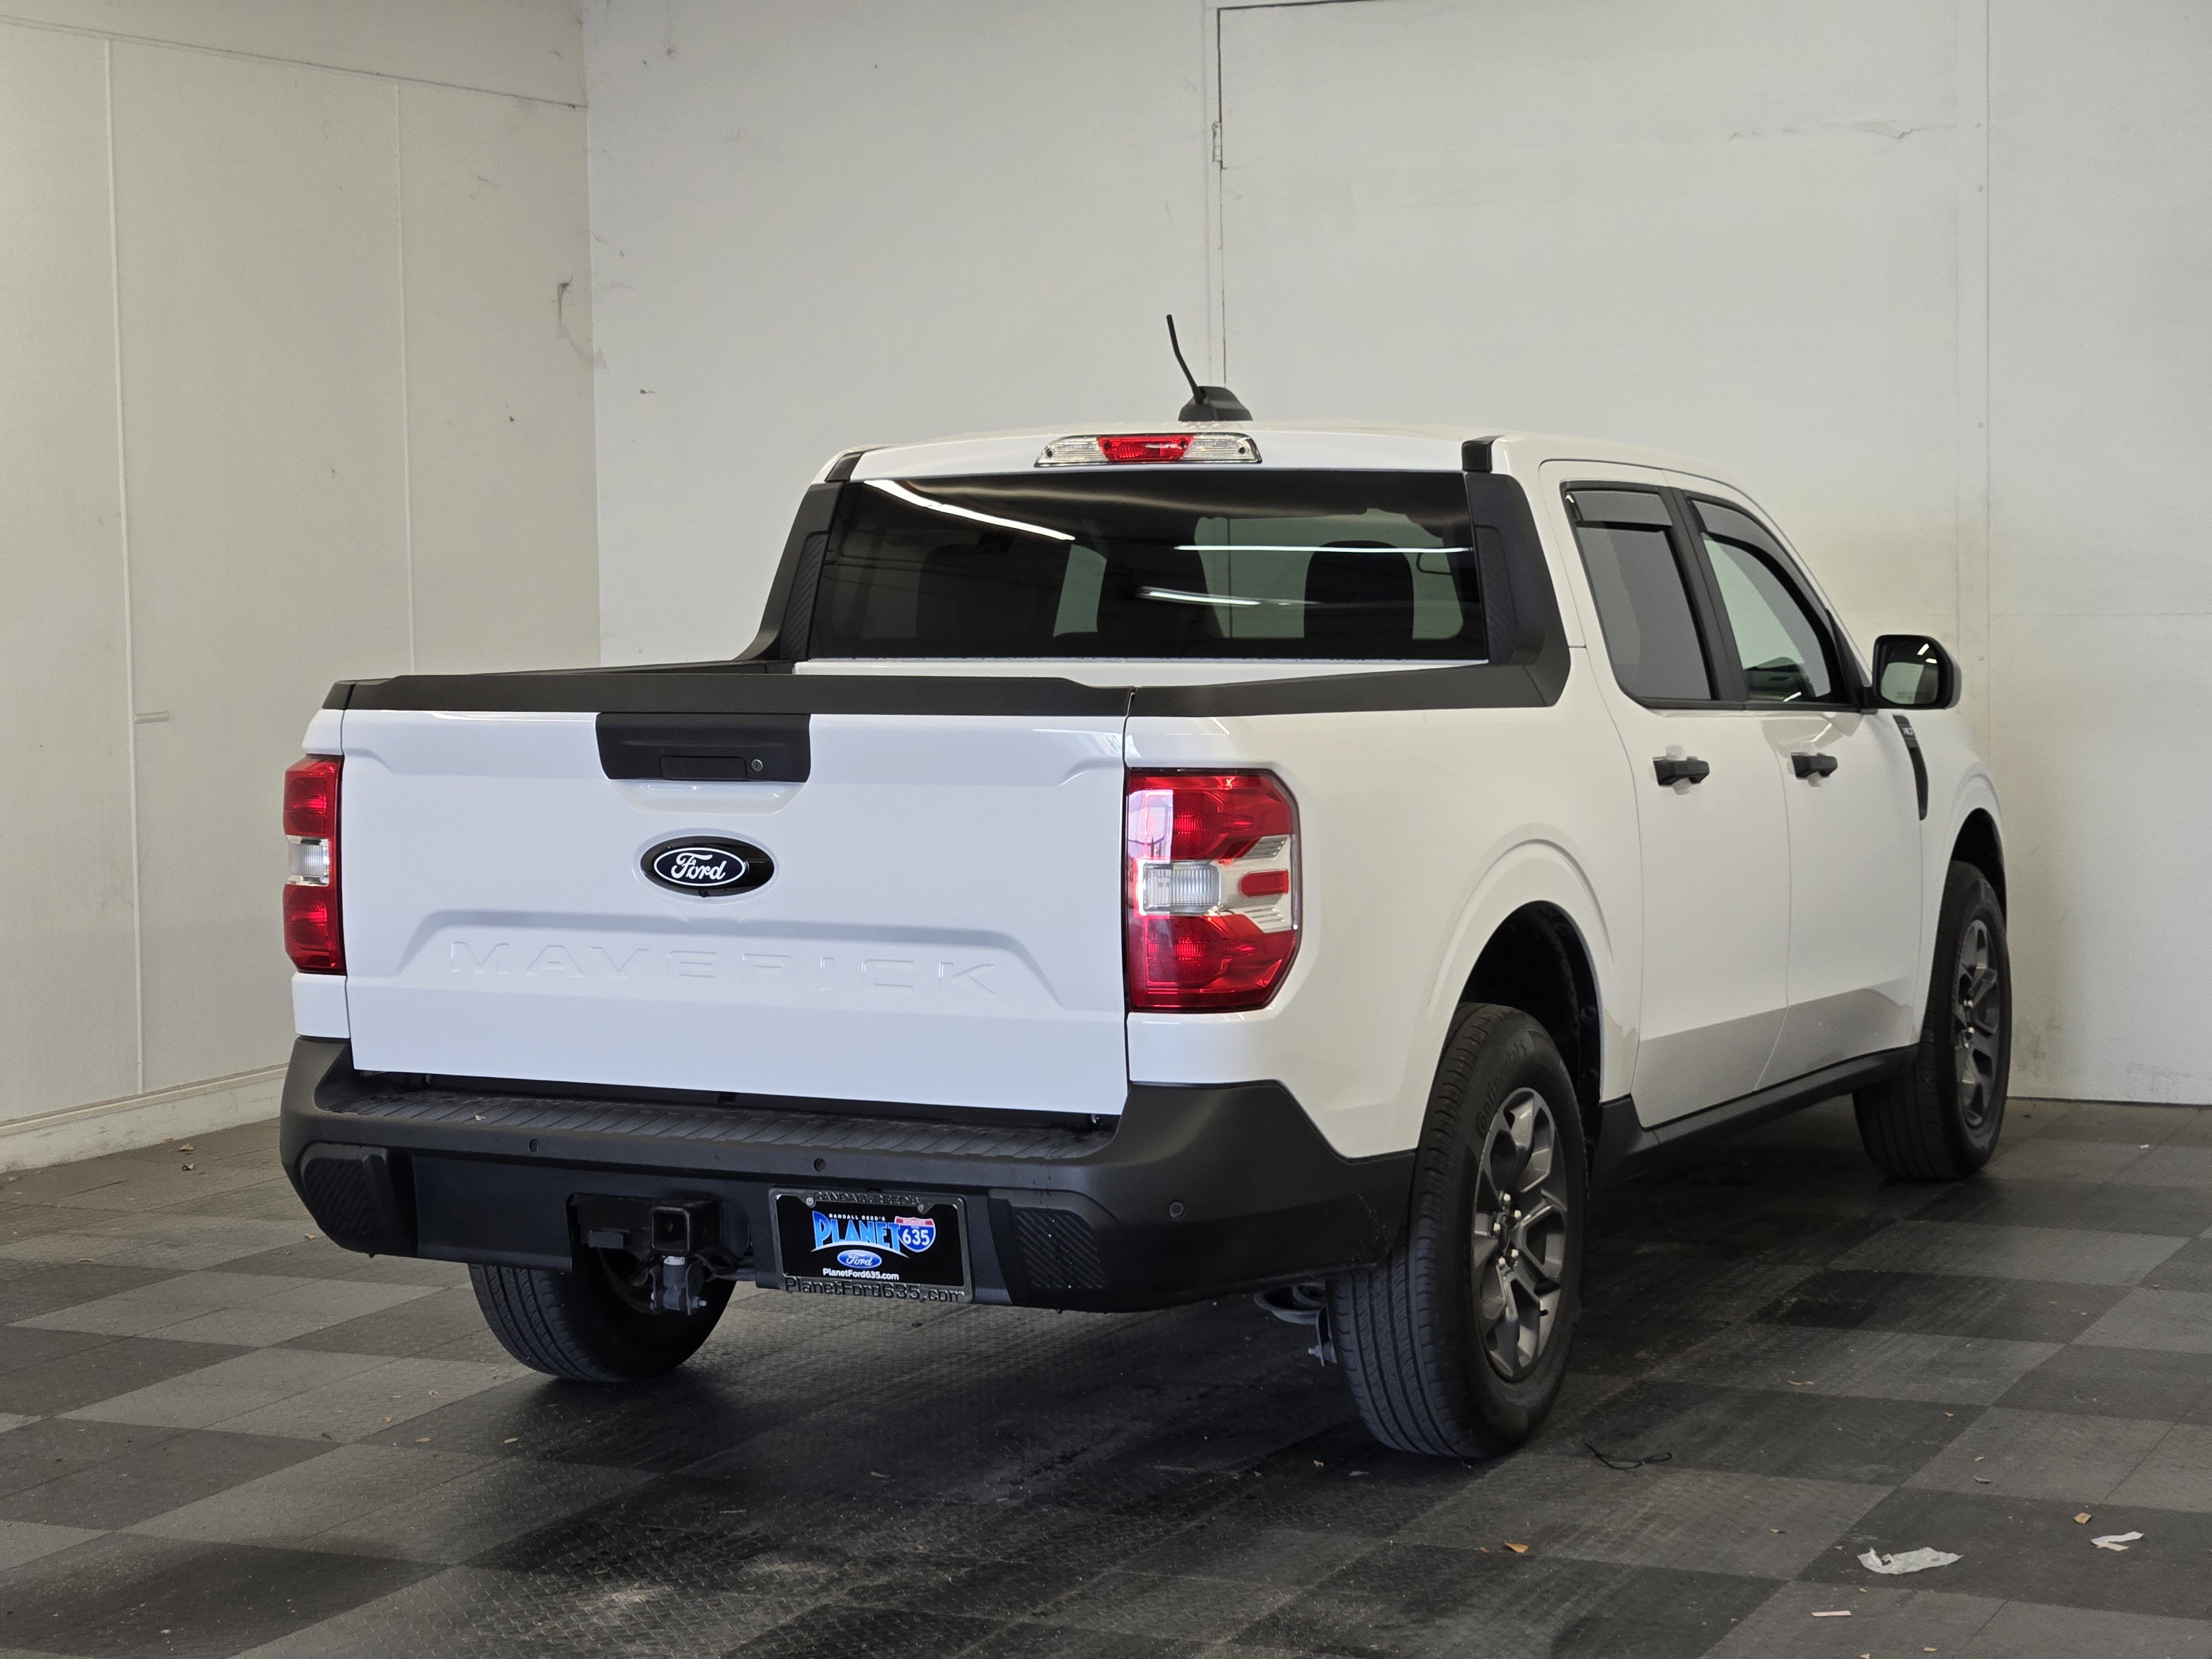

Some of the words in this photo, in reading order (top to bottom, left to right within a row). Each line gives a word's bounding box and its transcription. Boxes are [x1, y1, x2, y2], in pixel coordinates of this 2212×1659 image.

[671, 853, 727, 880] Ford
[450, 941, 996, 995] MAVERICK
[815, 1191, 873, 1203] RANDALL
[812, 1211, 901, 1252] PLANET
[902, 1228, 930, 1246] 635
[845, 1251, 874, 1267] Ford
[822, 1267, 899, 1281] PlanetFord635.com
[785, 1276, 965, 1303] PlanetFord635.com
